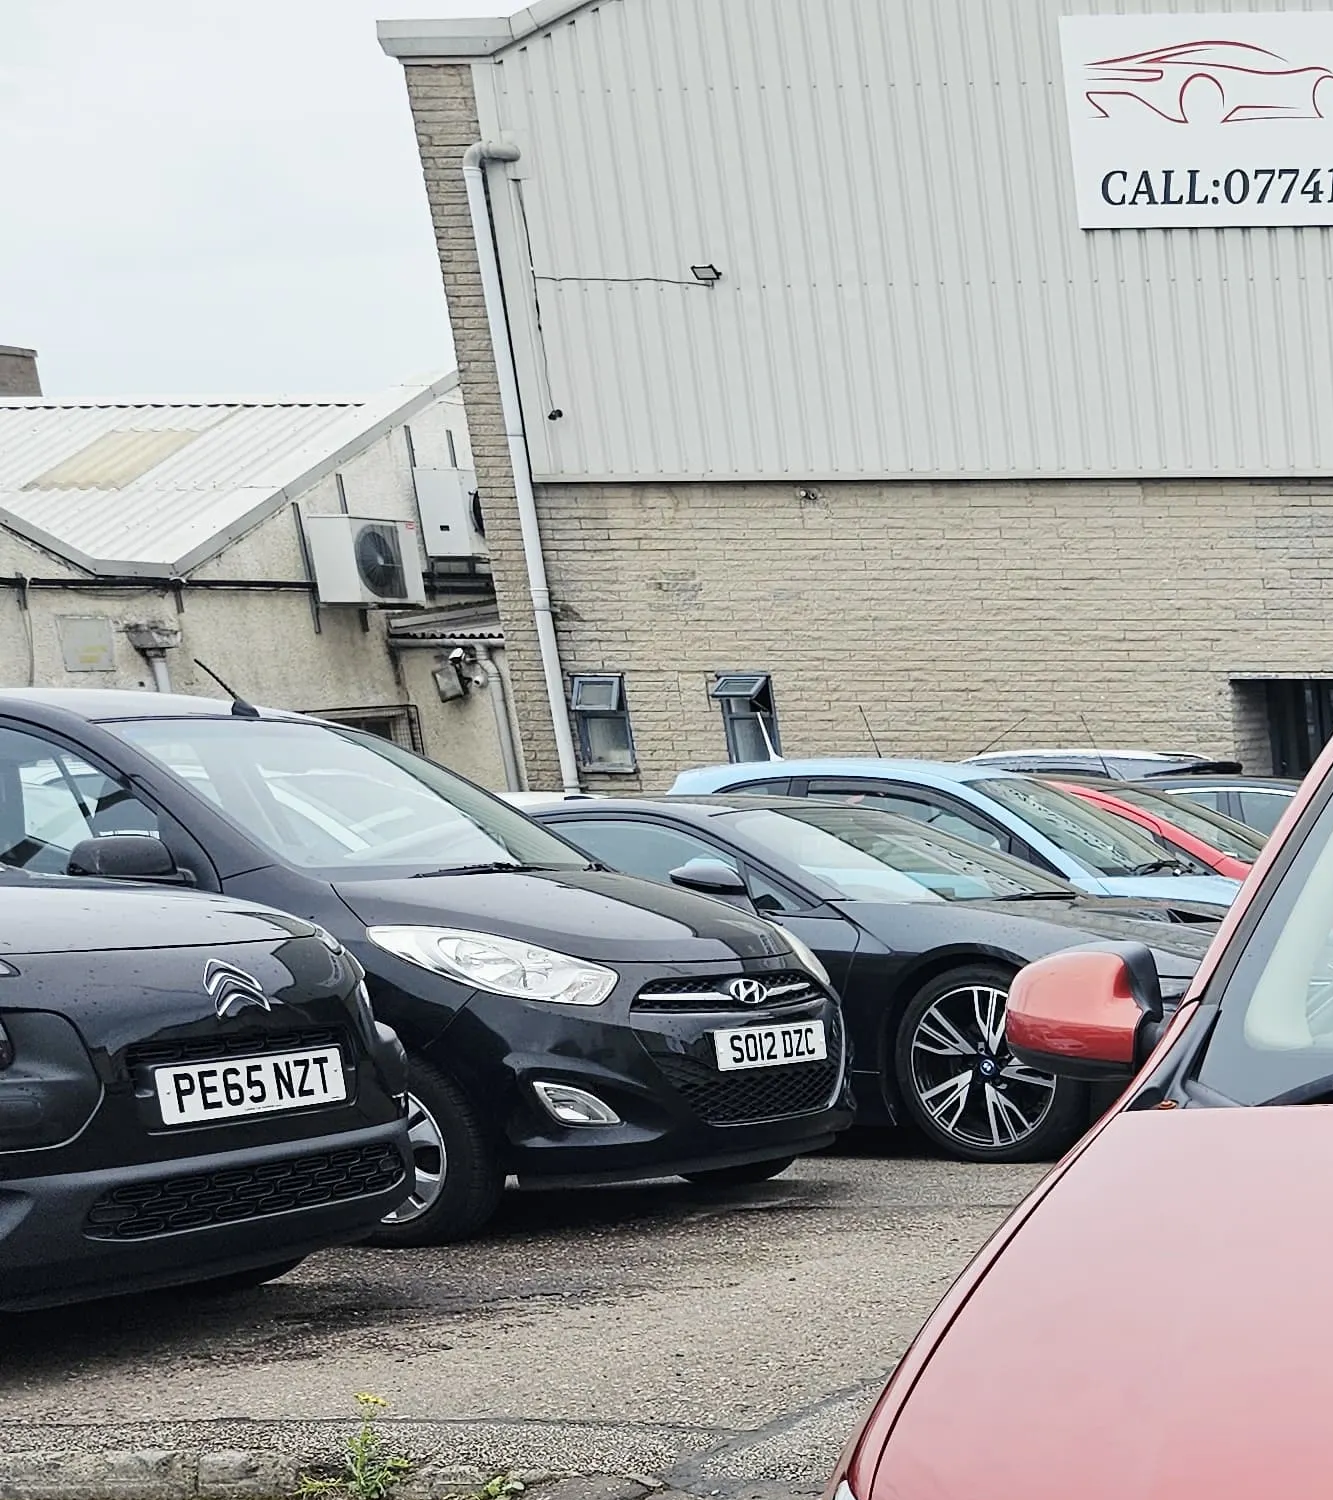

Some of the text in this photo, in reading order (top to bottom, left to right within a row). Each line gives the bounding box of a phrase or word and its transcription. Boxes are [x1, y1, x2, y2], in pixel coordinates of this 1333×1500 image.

[729, 1027, 816, 1064] SO12 DZC
[172, 1056, 330, 1114] PE65 NZT
